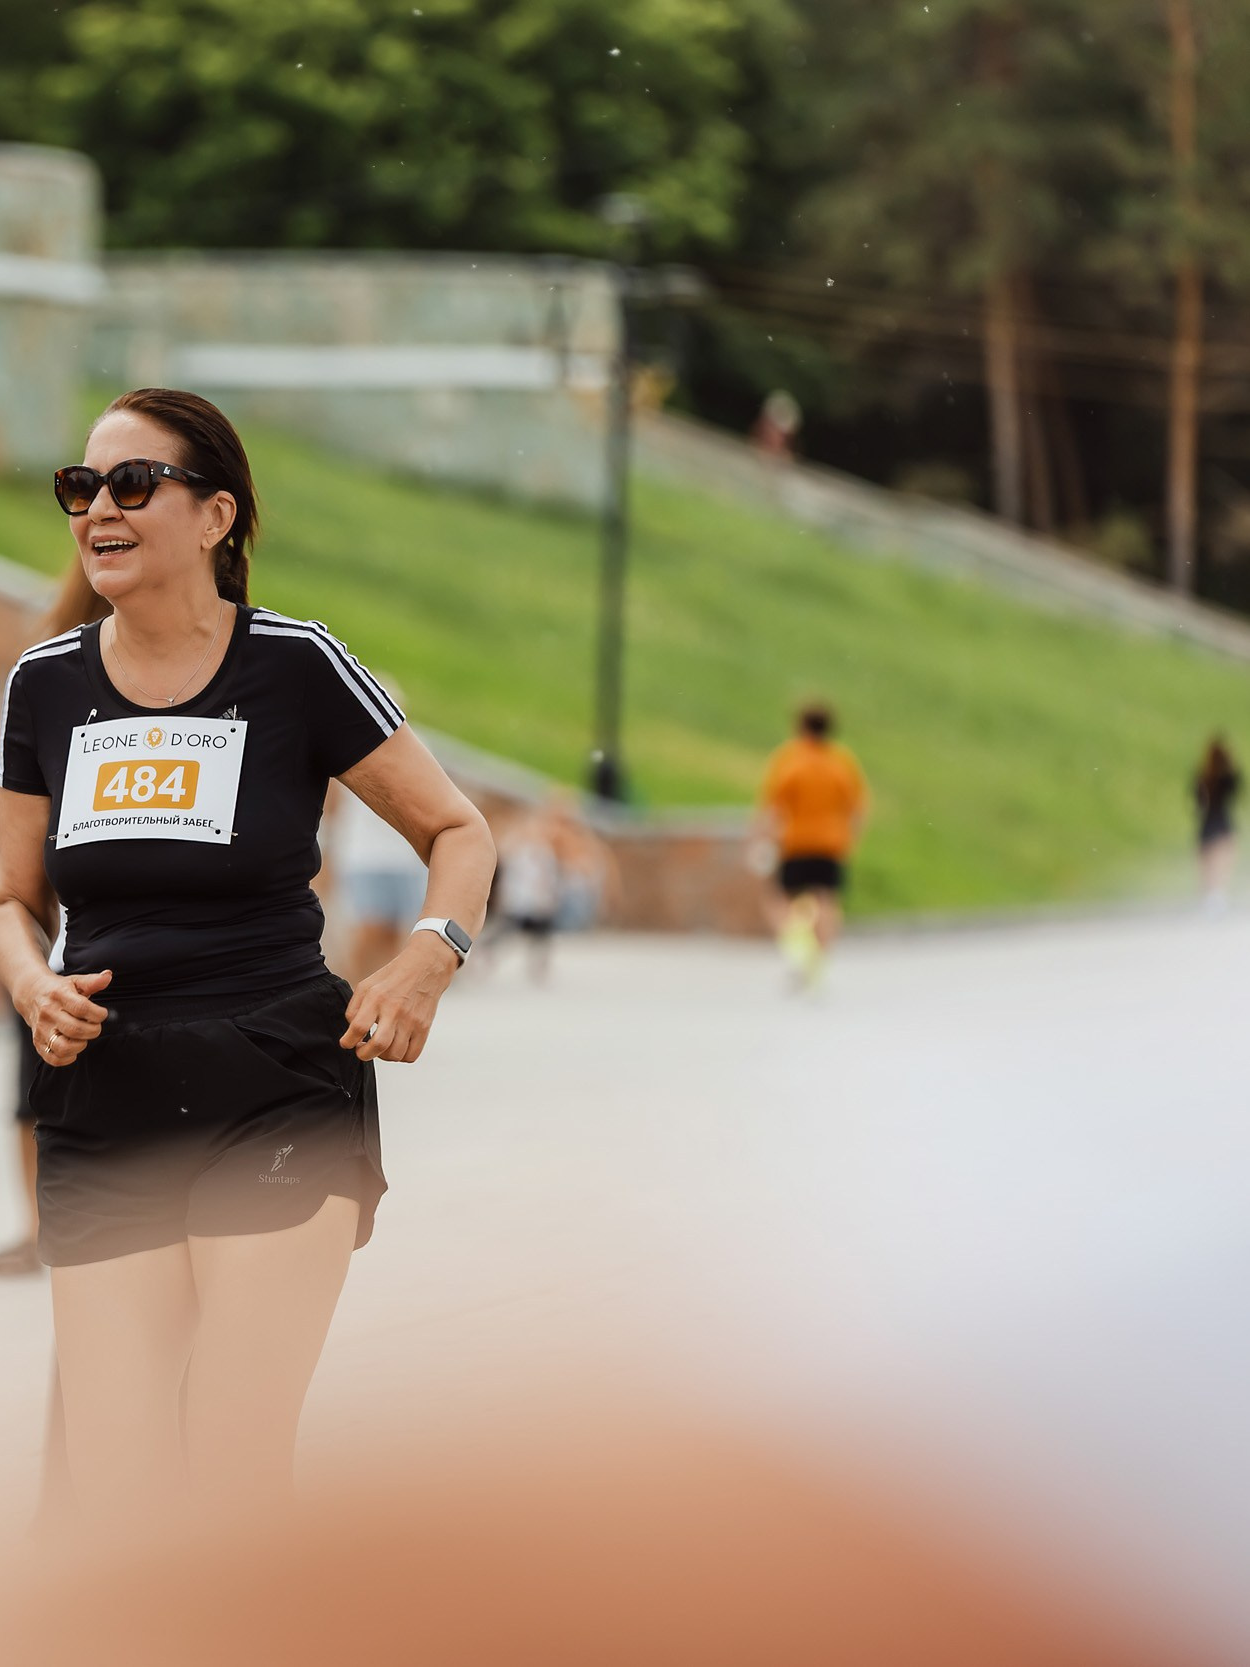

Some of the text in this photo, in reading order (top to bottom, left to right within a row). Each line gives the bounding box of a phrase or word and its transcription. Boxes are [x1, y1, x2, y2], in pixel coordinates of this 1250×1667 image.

[83, 733, 227, 753] LEONE D'ORO
[102, 765, 186, 803] 484
[72, 814, 214, 832] БЛАГОТВОРИТЕЛЬНЫЙ ЗАБЕГ
